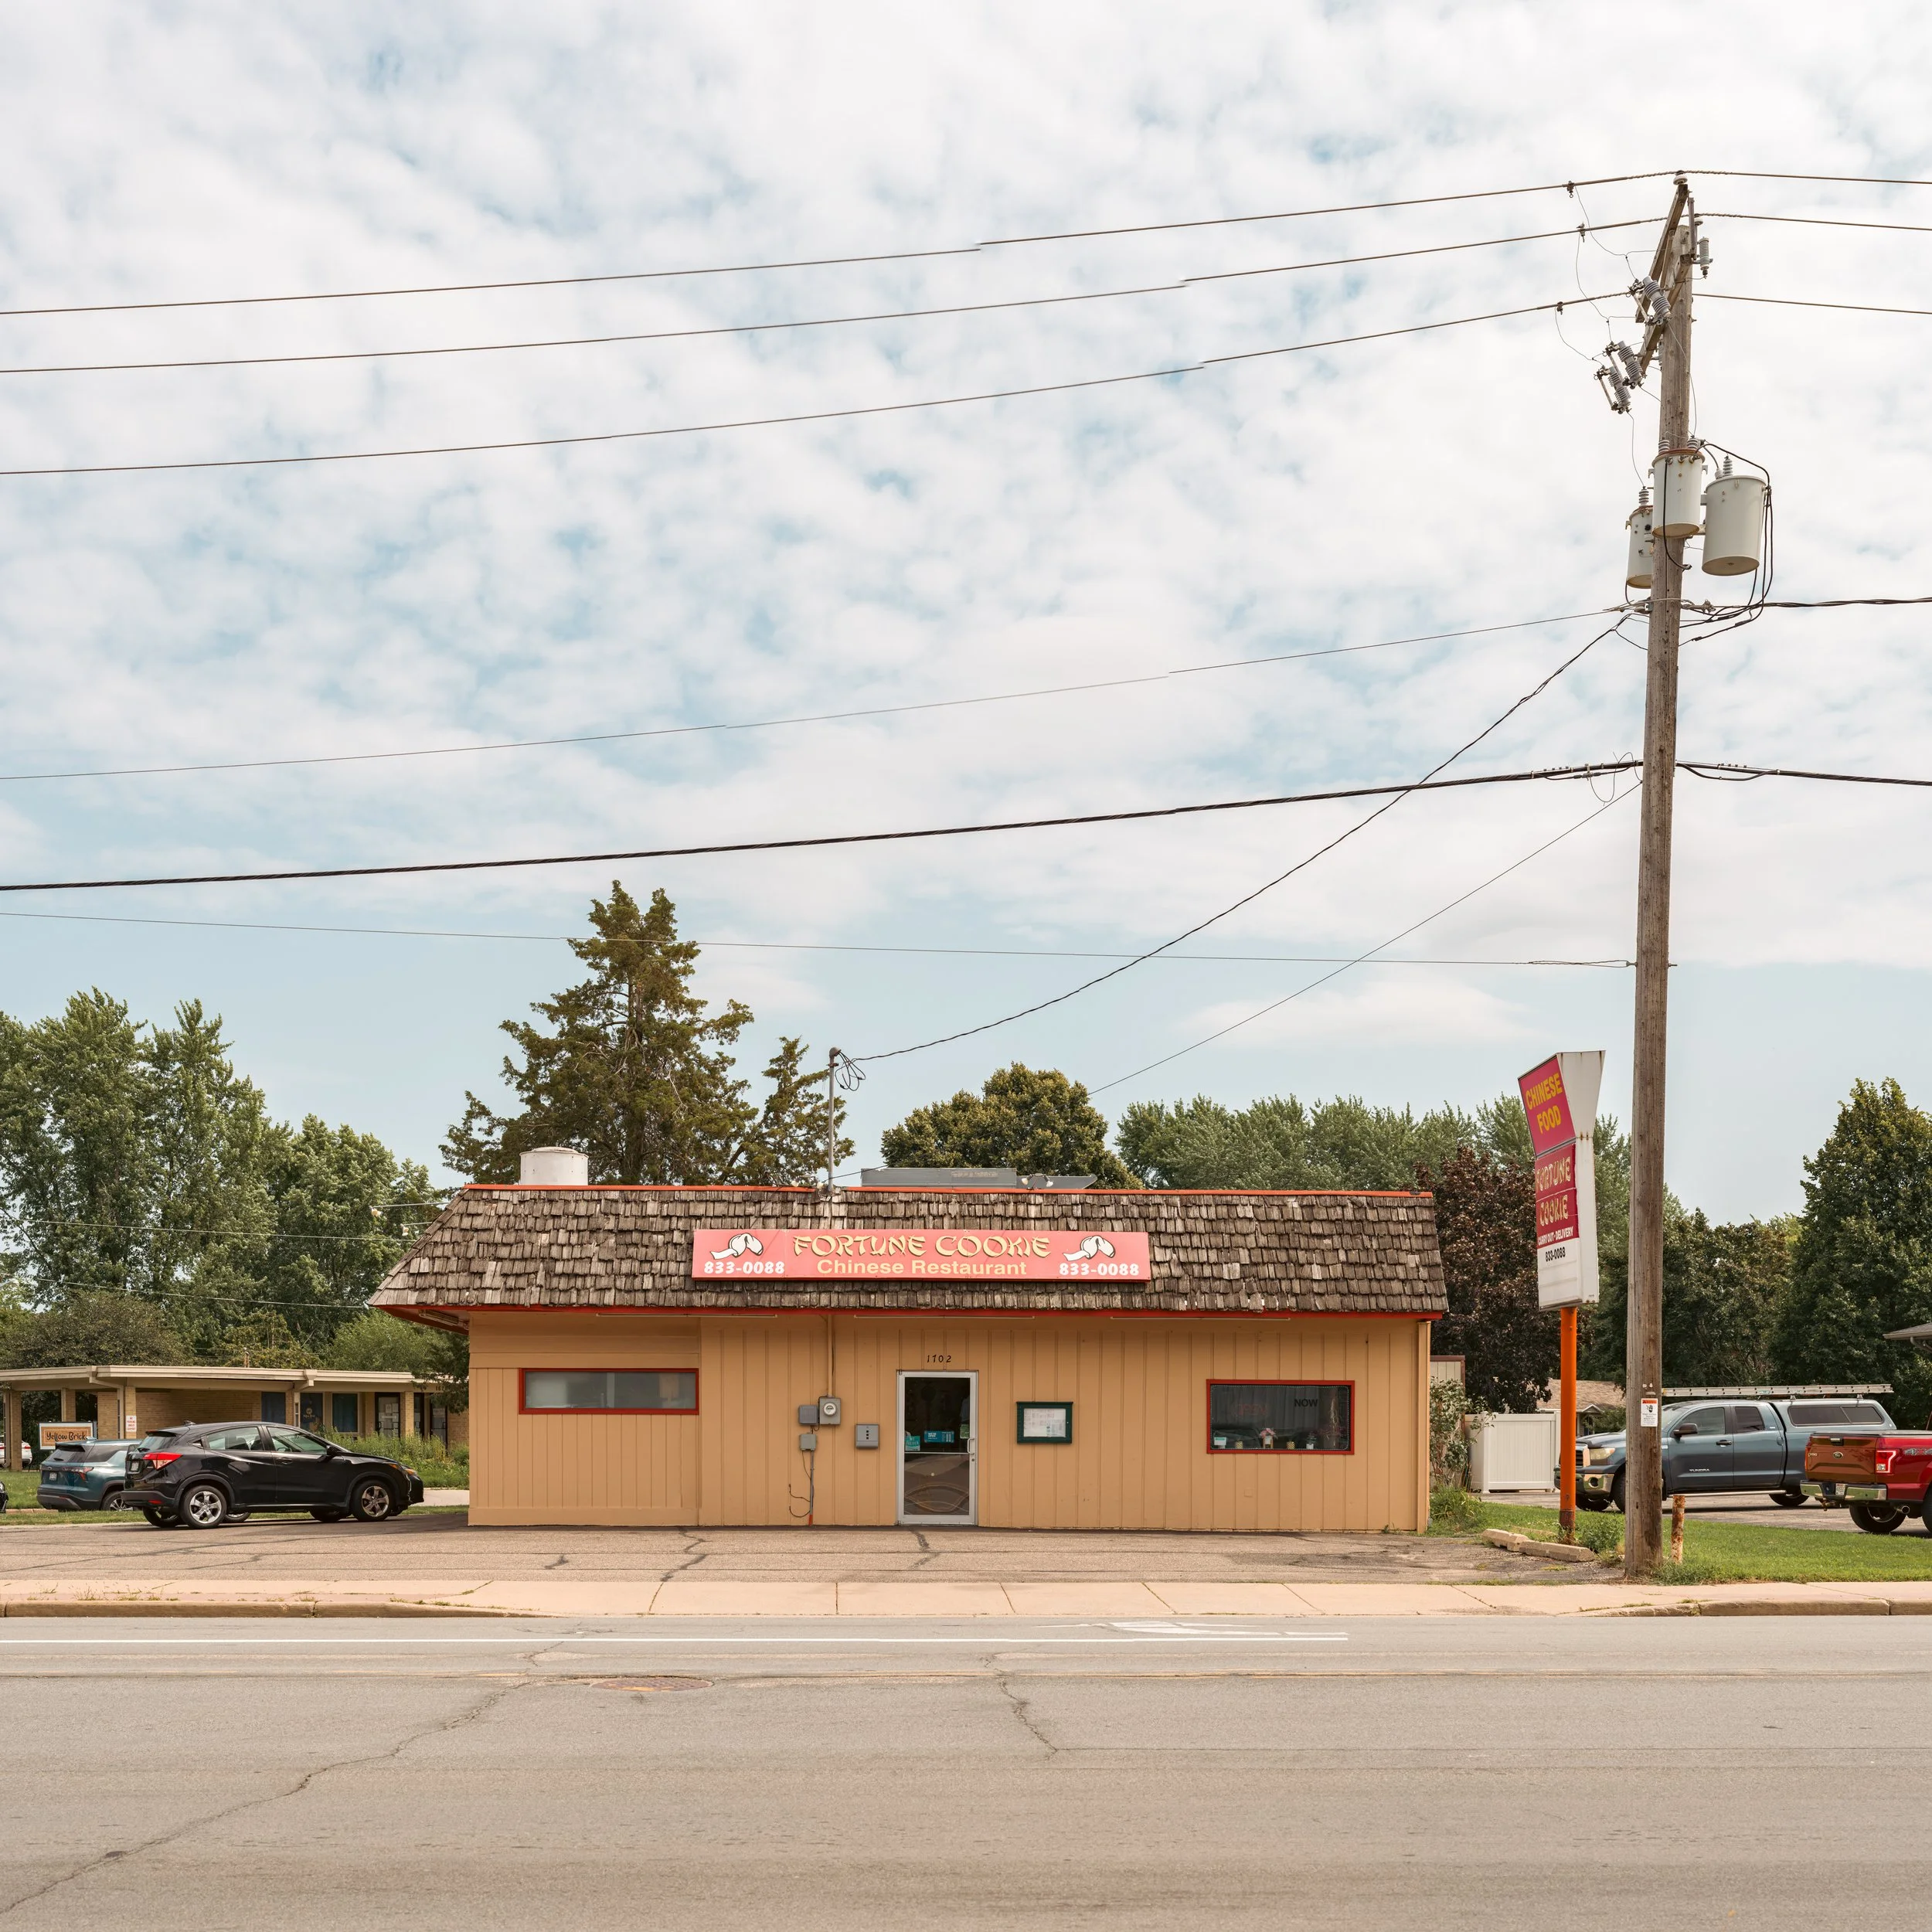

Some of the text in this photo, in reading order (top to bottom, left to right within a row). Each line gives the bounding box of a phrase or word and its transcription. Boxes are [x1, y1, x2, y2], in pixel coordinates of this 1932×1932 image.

[1526, 1073, 1563, 1111] CHINESE
[1536, 1105, 1561, 1134] FOOD
[1536, 1156, 1571, 1193] FORTUNE
[1539, 1194, 1568, 1226] COOKIE
[1555, 1226, 1573, 1240] DELIVERY
[792, 1234, 1051, 1257] FORTUNE COOKIE
[1546, 1247, 1566, 1262] 833-0088
[703, 1261, 784, 1274] 833-0088
[817, 1259, 1026, 1275] Chinese Restaurant
[1059, 1263, 1139, 1276] 833-0088
[927, 1354, 951, 1362] 1702
[46, 1431, 67, 1441] Yellow
